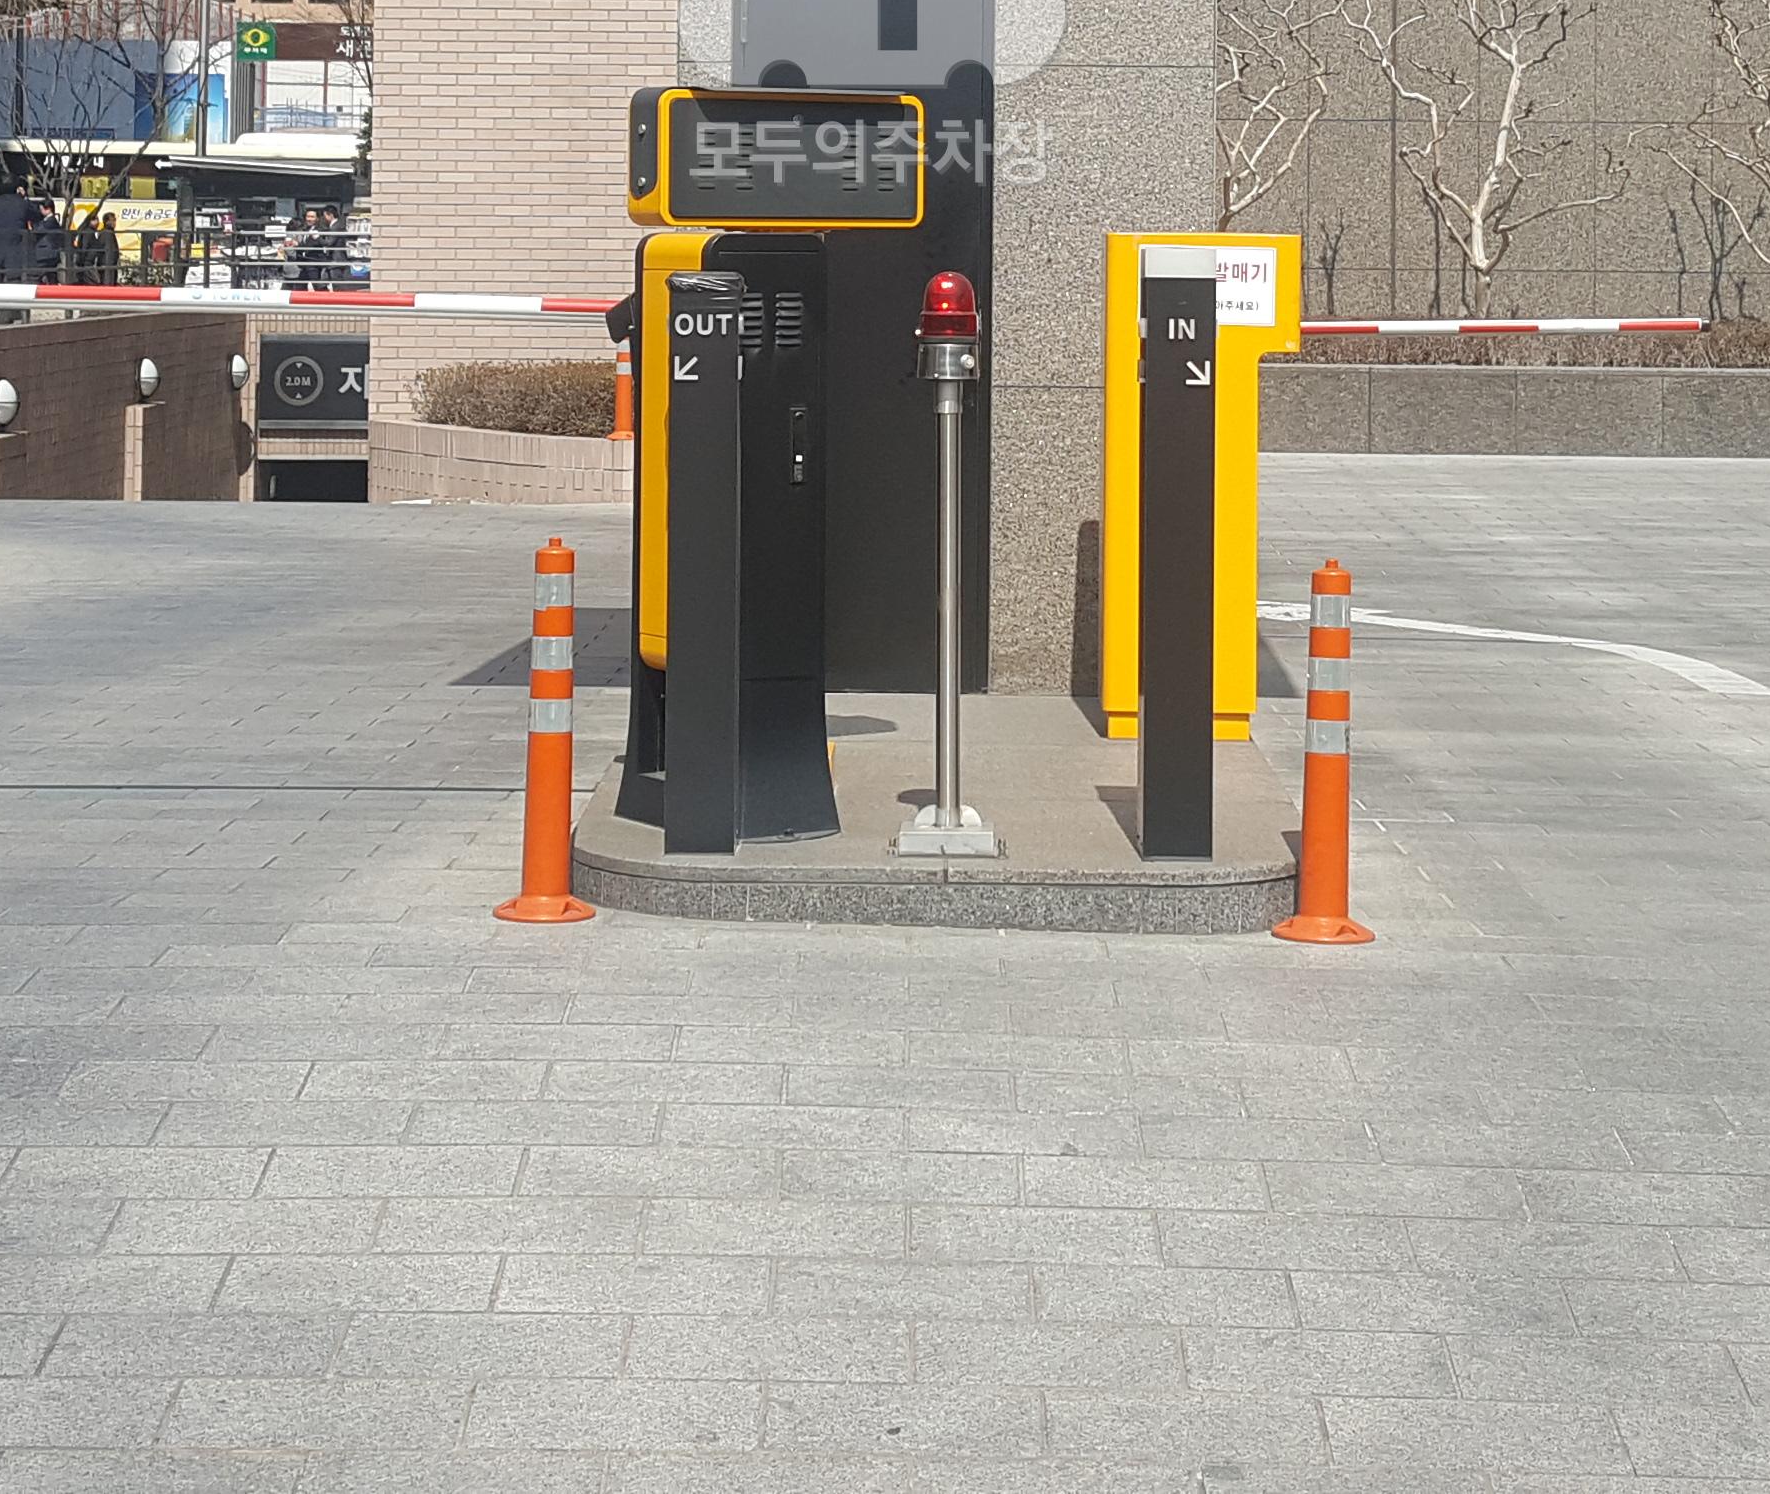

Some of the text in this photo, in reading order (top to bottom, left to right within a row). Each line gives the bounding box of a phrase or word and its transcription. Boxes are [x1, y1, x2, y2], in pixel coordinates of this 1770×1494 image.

[674, 312, 733, 336] OUT
[1167, 317, 1196, 340] IN
[285, 376, 311, 387] 2.0M
